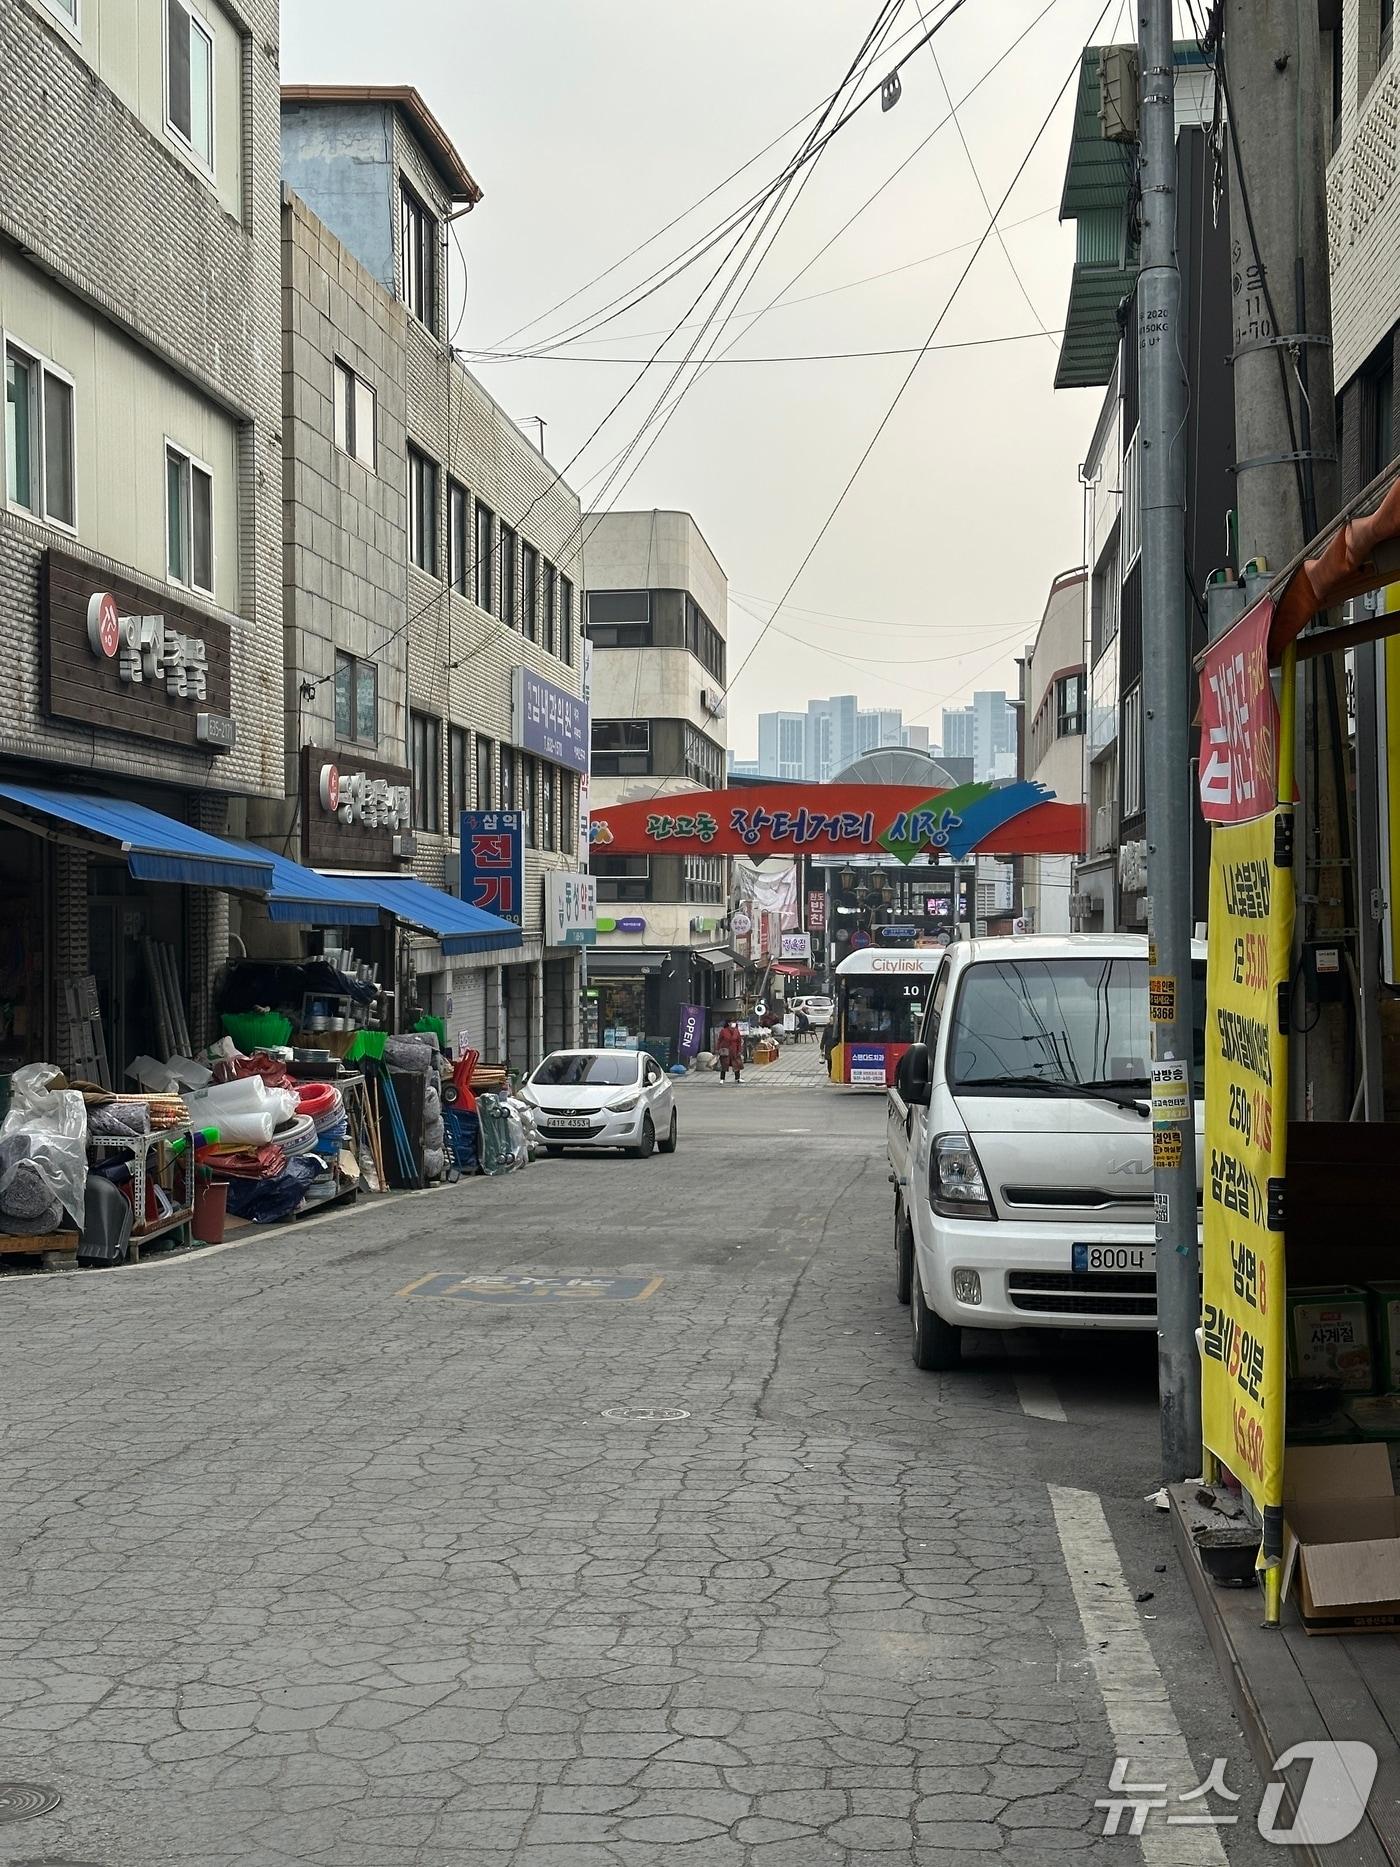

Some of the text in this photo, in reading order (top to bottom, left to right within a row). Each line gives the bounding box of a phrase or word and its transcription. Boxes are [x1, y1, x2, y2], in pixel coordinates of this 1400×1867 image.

[482, 814, 518, 831] 삼익
[646, 806, 962, 847] 관고동 장터거리 시장
[471, 833, 513, 912] 전기
[810, 901, 825, 925] 반찬
[872, 958, 924, 973] Citylink
[903, 986, 920, 996] 10
[682, 1017, 696, 1048] OPEN
[1152, 1068, 1183, 1082] 남방송
[1229, 1083, 1251, 1147] 250g
[1090, 1248, 1144, 1269] 800나
[1231, 1239, 1258, 1309] 냉면
[1311, 1326, 1355, 1344] 사계절
